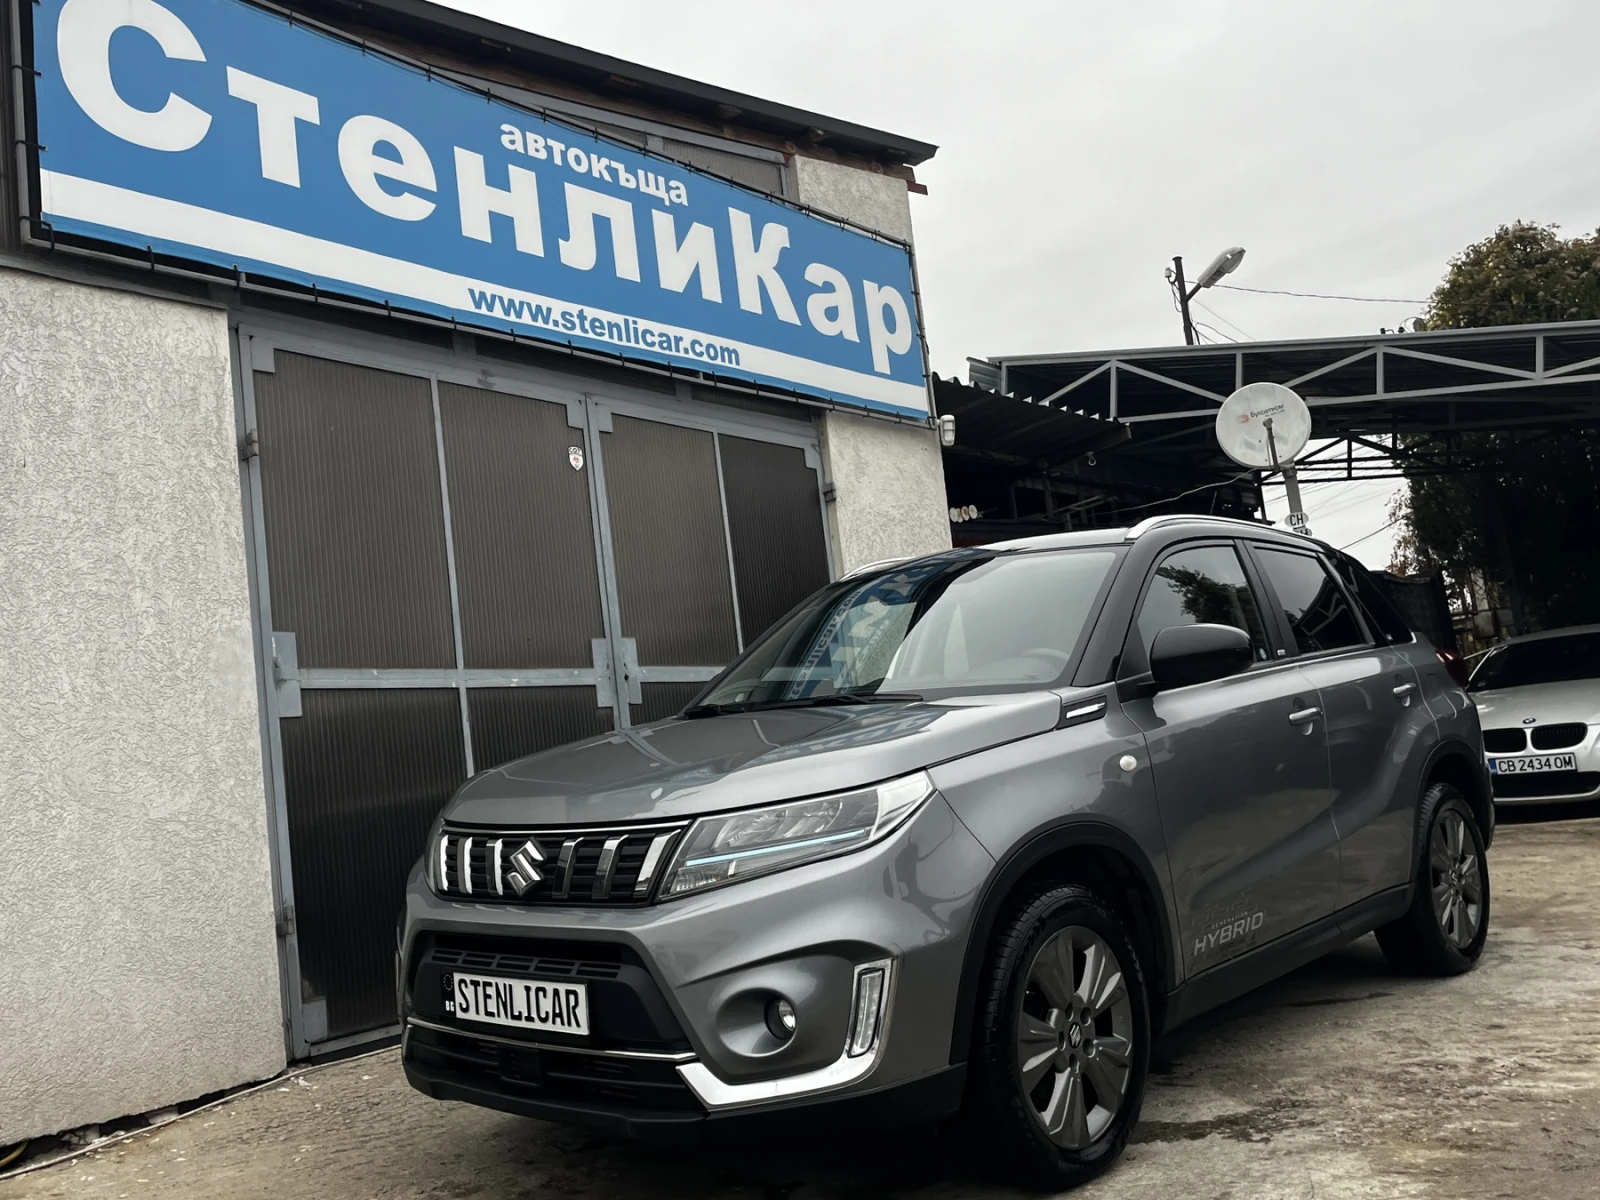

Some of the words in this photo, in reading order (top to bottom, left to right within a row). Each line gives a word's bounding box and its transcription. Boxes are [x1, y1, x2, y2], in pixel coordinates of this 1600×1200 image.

[57, 0, 912, 374] СтенлиКар
[500, 123, 689, 207] автокъща
[468, 288, 740, 367] www.stenlicar.com
[1289, 513, 1304, 526] CH
[1498, 760, 1516, 773] CB
[1518, 758, 1551, 772] 2434
[1554, 756, 1573, 769] OM
[1194, 912, 1264, 956] HYBRID
[458, 978, 581, 1028] STENLICAR
